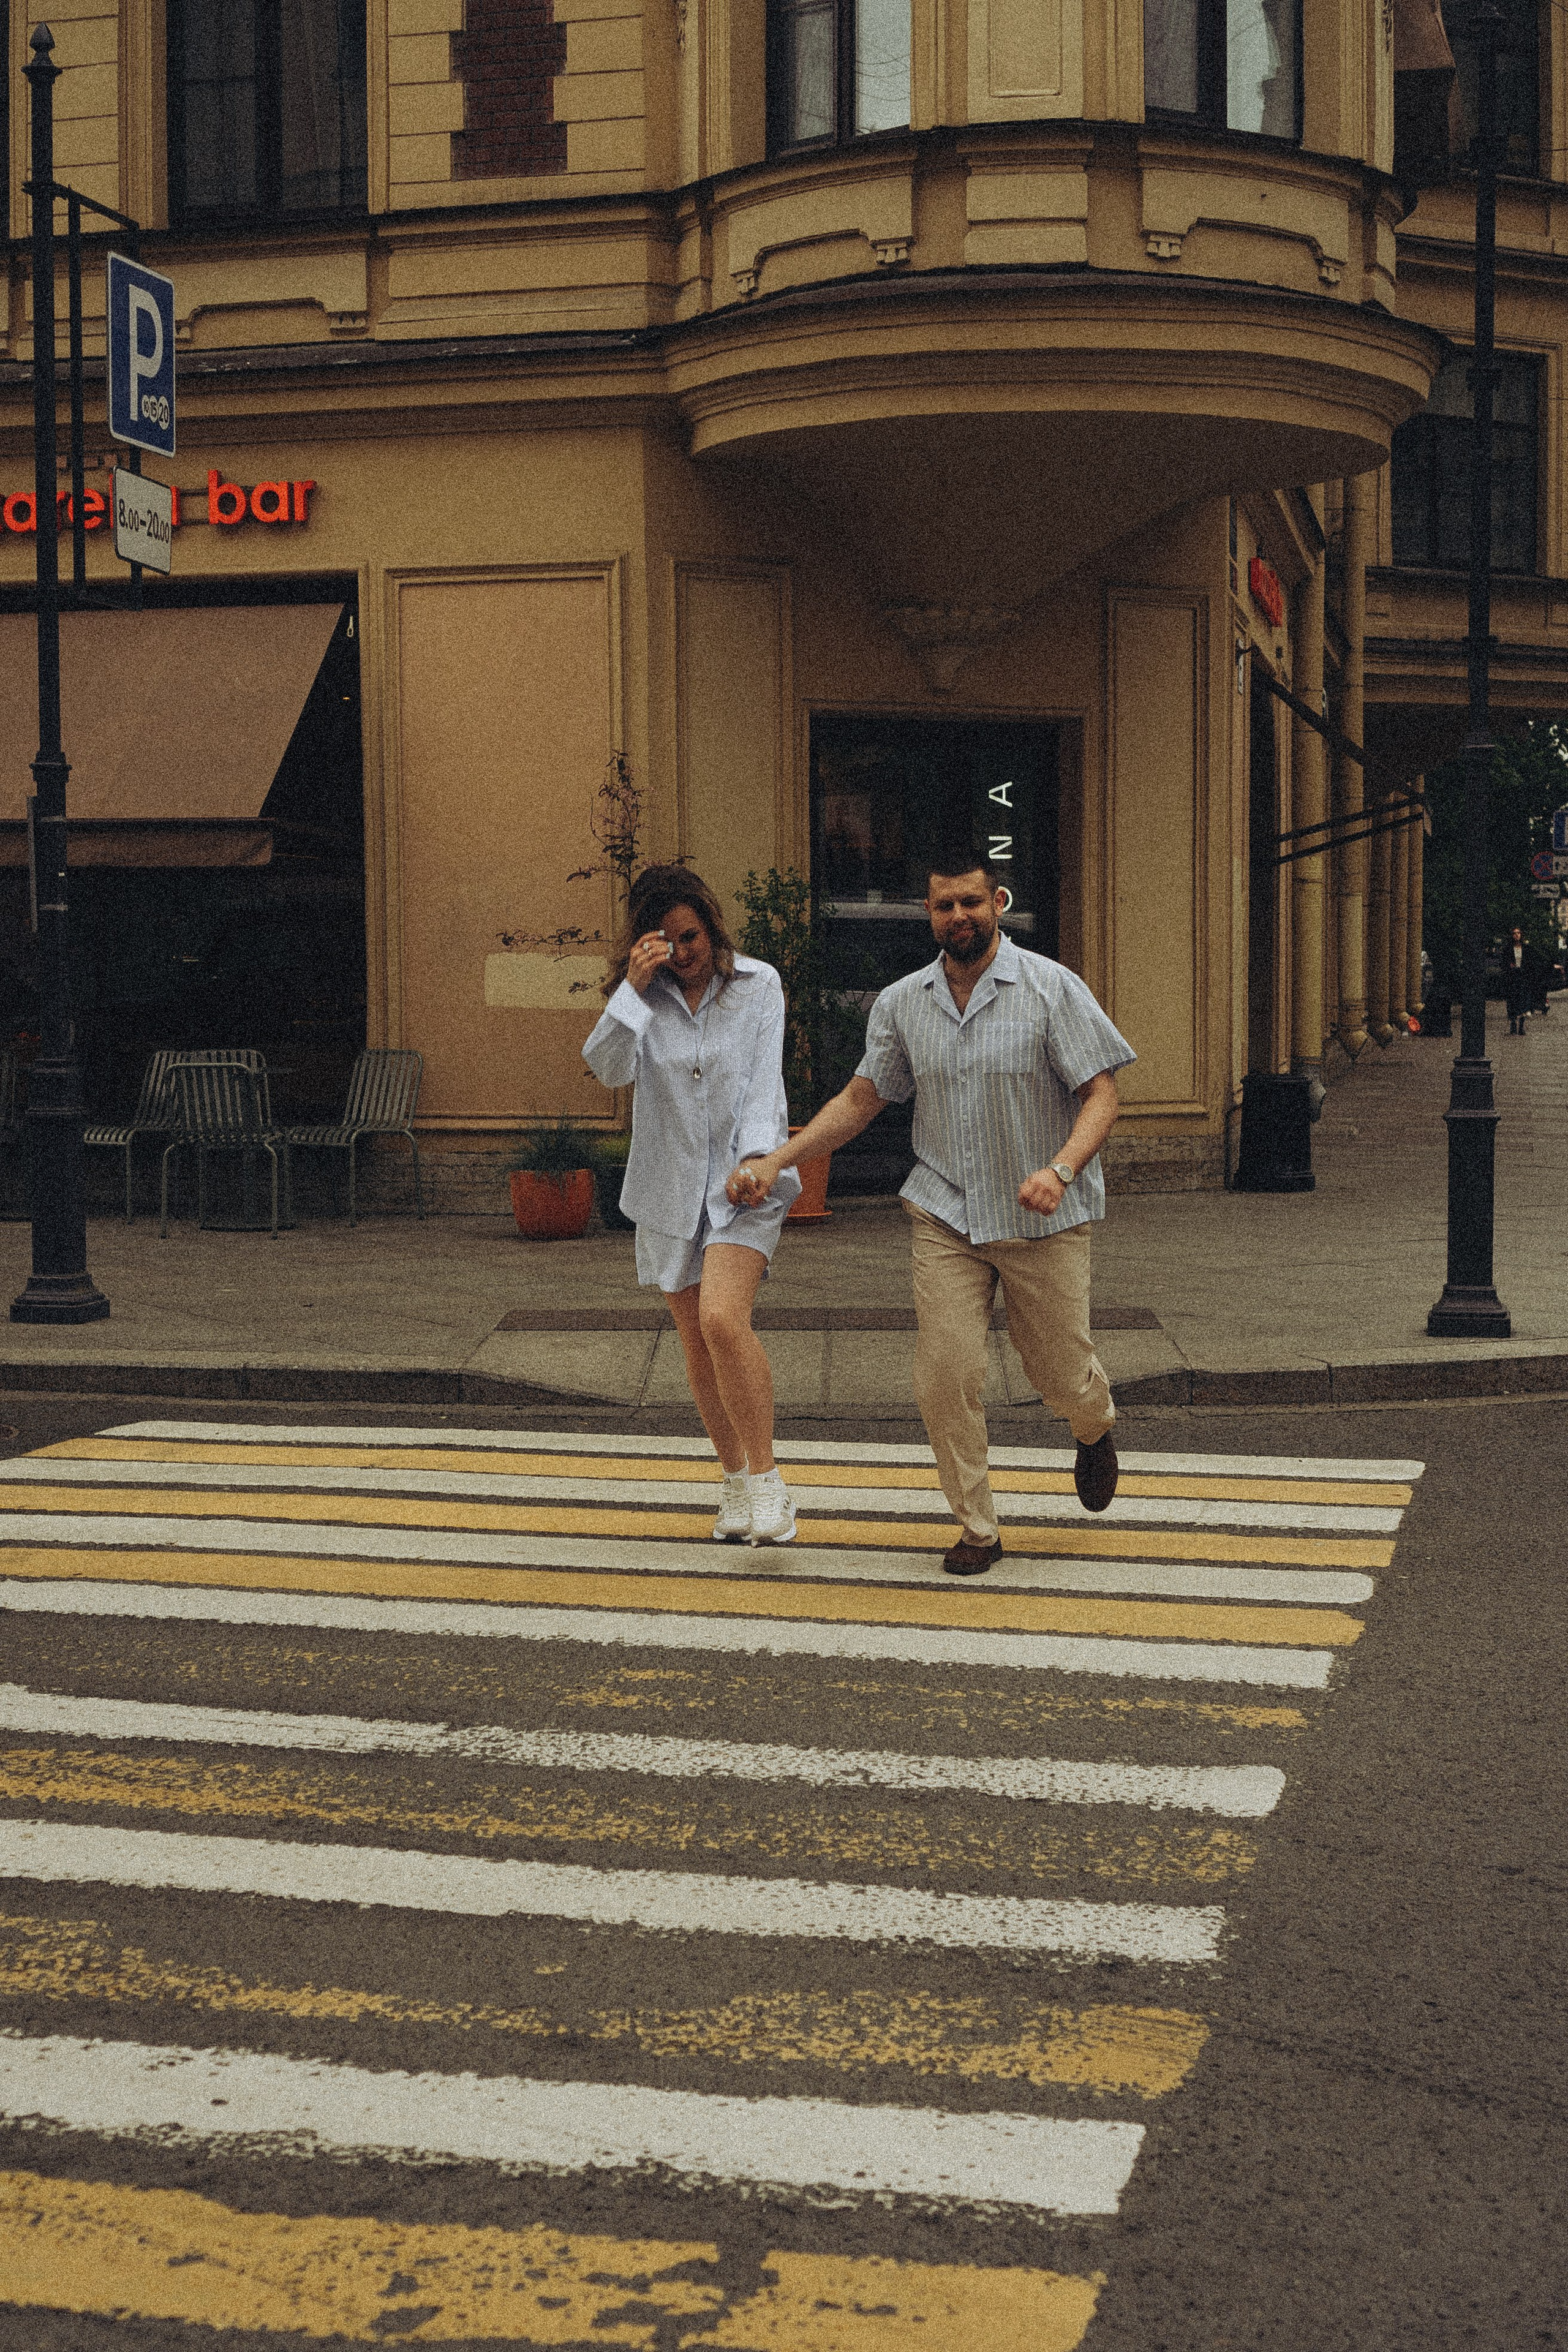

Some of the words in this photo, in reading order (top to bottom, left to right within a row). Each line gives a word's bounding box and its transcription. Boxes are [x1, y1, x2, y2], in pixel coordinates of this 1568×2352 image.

[129, 283, 163, 421] P
[159, 402, 169, 423] 20
[207, 469, 317, 525] bar
